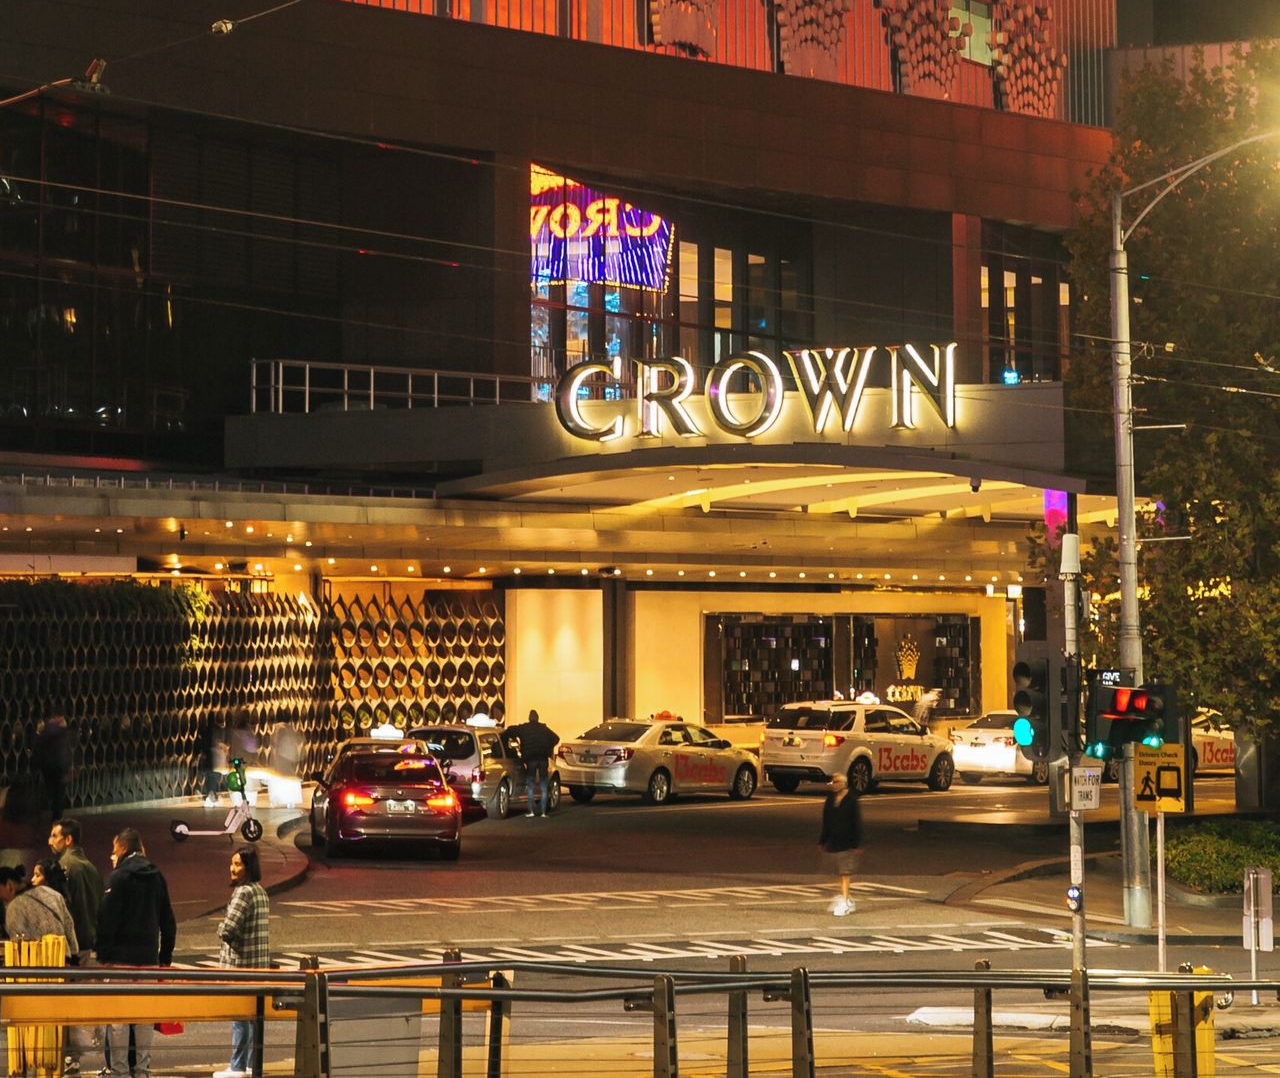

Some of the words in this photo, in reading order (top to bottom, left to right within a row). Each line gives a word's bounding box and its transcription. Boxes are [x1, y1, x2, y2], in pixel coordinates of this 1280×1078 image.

[555, 342, 958, 441] CROWN
[1102, 672, 1120, 682] GIVE
[878, 746, 928, 771] 13cabs
[1203, 741, 1235, 763] 13cab
